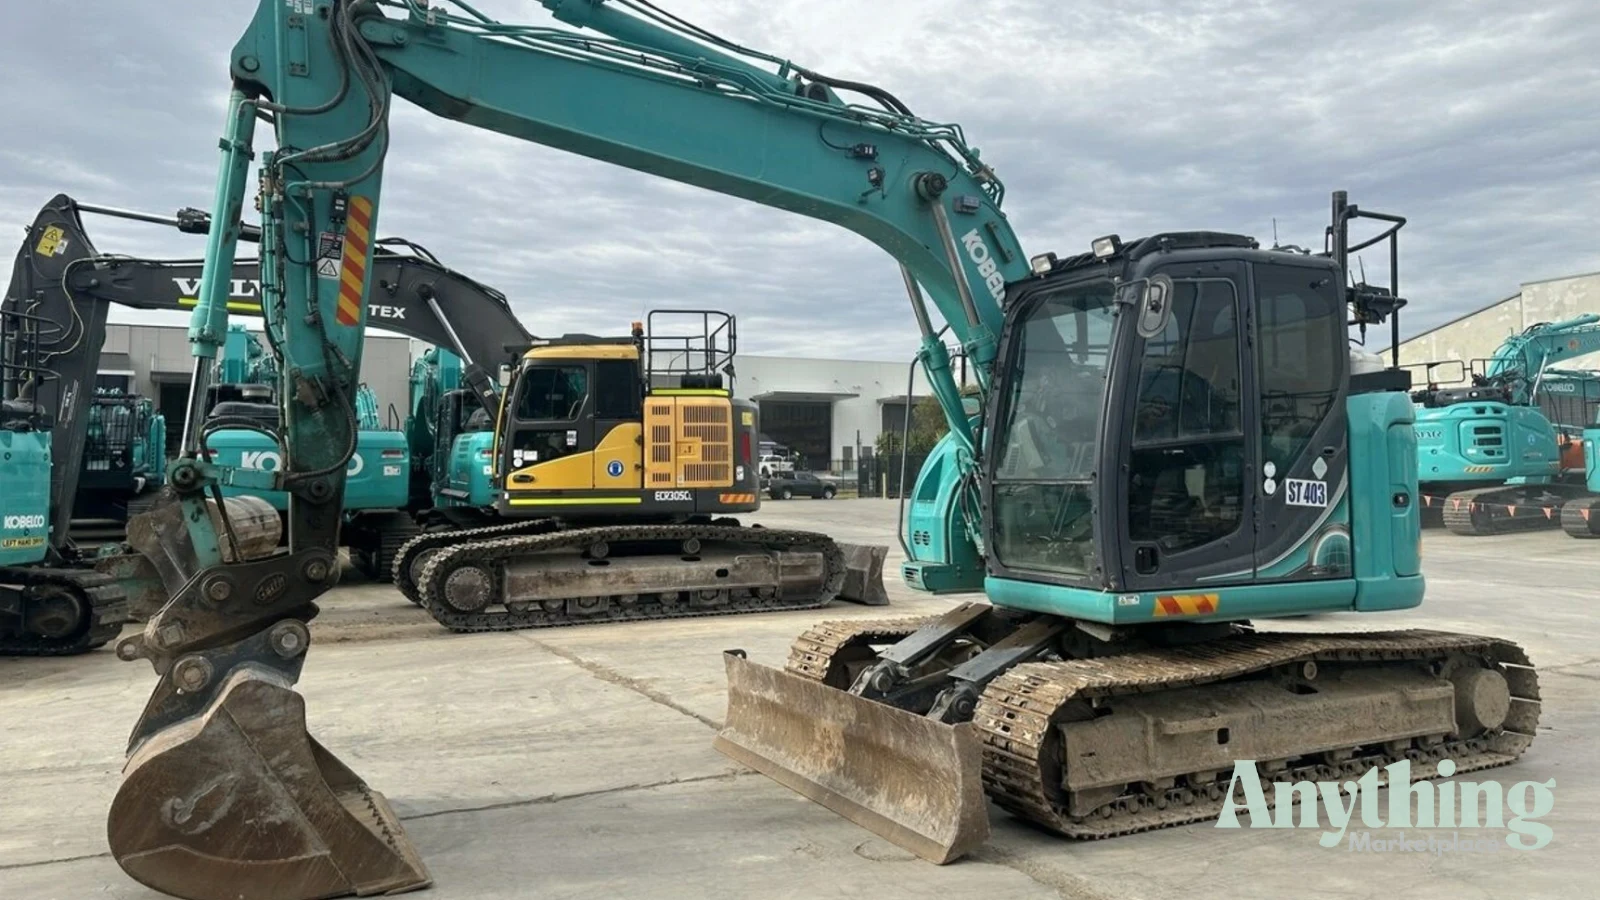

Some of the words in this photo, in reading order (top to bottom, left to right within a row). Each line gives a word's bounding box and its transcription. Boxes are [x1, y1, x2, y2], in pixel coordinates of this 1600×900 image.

[961, 228, 1006, 316] KOBEL
[1288, 481, 1302, 504] ST
[1303, 482, 1325, 505] 403
[4, 514, 45, 529] KOBELCO
